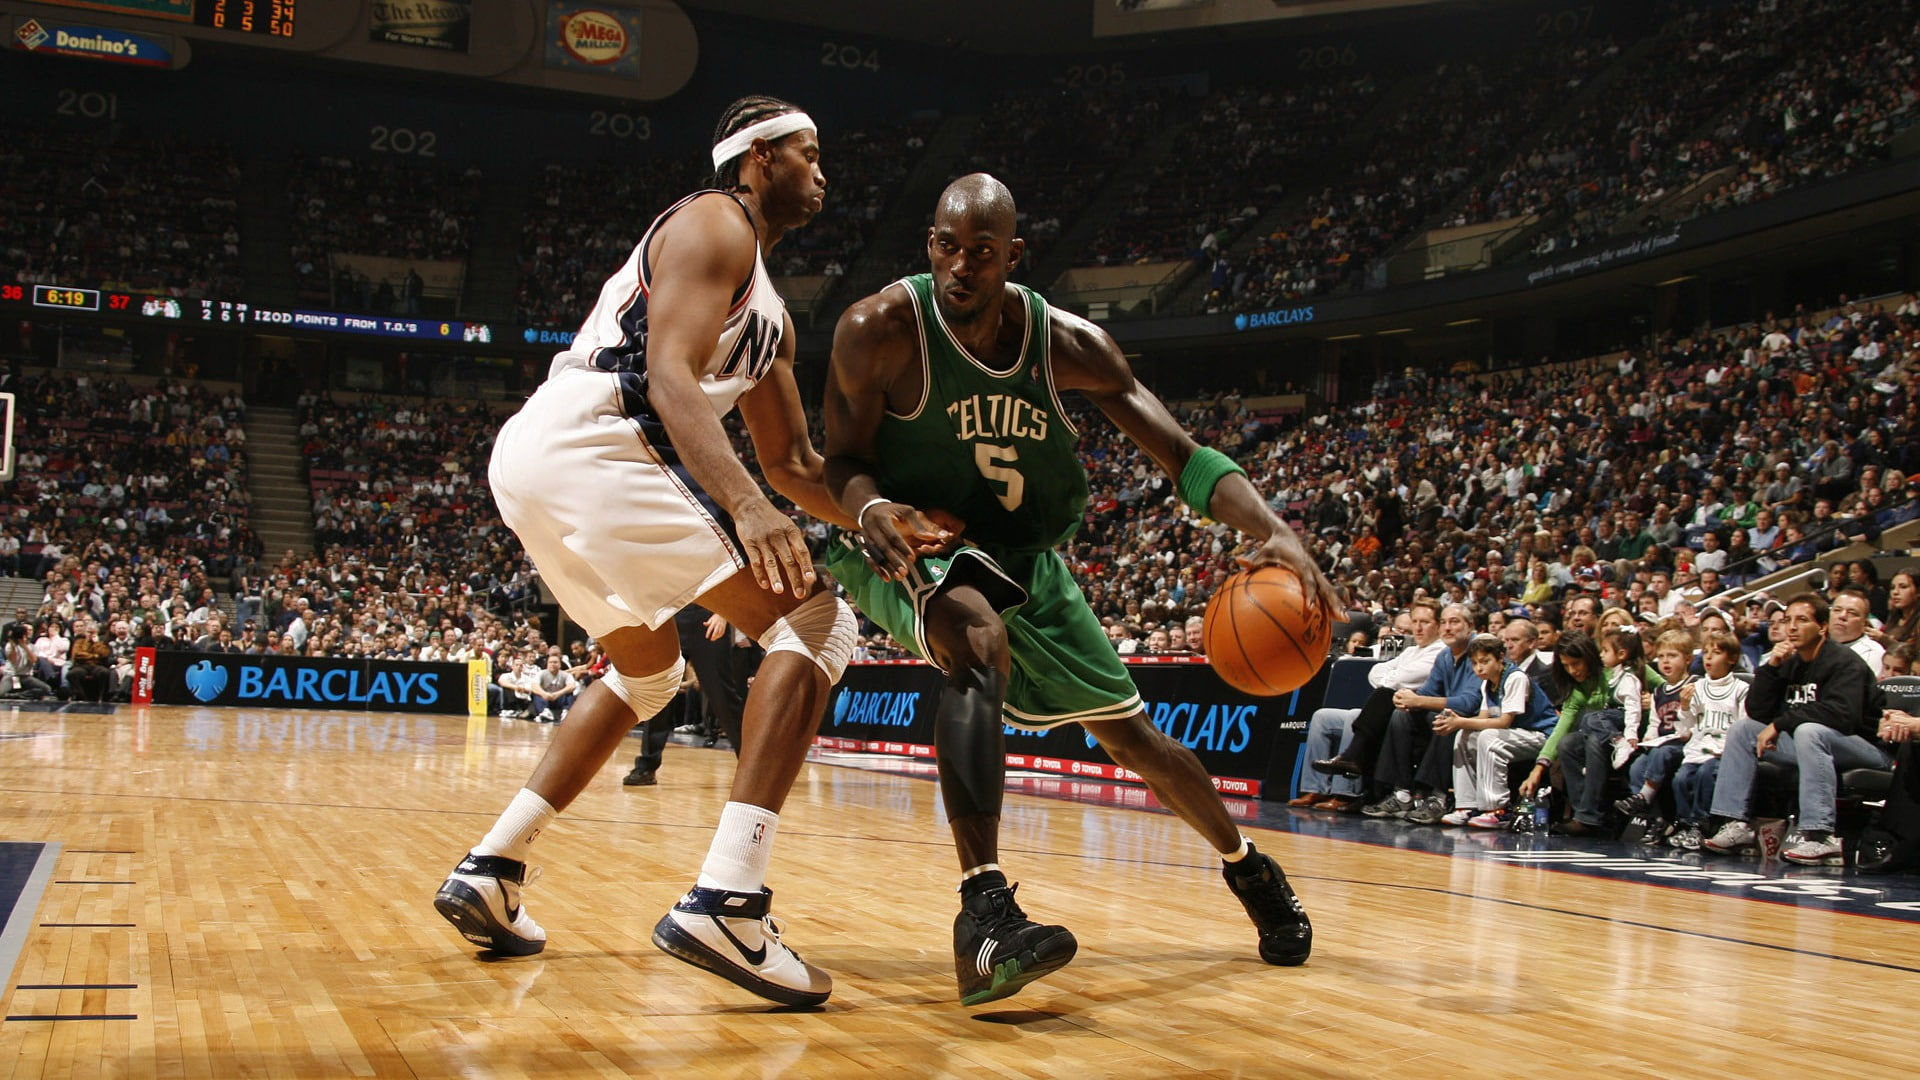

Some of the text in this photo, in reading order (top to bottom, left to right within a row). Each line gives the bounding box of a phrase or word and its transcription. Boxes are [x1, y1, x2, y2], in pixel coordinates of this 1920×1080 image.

[374, 3, 413, 21] The
[241, 16, 253, 31] 5
[270, 20, 294, 37] 50
[579, 21, 622, 41] MEGA
[56, 30, 138, 56] Domino's
[821, 42, 881, 72] 204
[1067, 61, 1127, 88] 205
[56, 88, 118, 120] 201
[589, 109, 651, 140] 203
[370, 125, 437, 157] 202
[1, 284, 131, 310] 36 6:19 37
[202, 309, 211, 320] 2
[238, 312, 245, 323] 1
[254, 310, 292, 324] IZOD
[295, 313, 339, 327] POINTS
[344, 318, 378, 331] FROM
[439, 323, 450, 336] 6
[1249, 305, 1315, 329] BARCLAYS
[540, 331, 577, 345] BARC
[715, 308, 780, 384] NE
[975, 442, 1025, 512] 5
[238, 665, 439, 705] BARCLAYS
[846, 691, 920, 728] BARCLAYS
[1697, 710, 1734, 732] CLTICS
[1145, 702, 1258, 753] RCLAYS
[1280, 721, 1307, 730] MARQUIS
[1042, 760, 1061, 769] TOYOTA
[1081, 765, 1102, 775] TOYOTA
[1125, 770, 1143, 780] TOYO
[1222, 779, 1248, 792] TOYOTA
